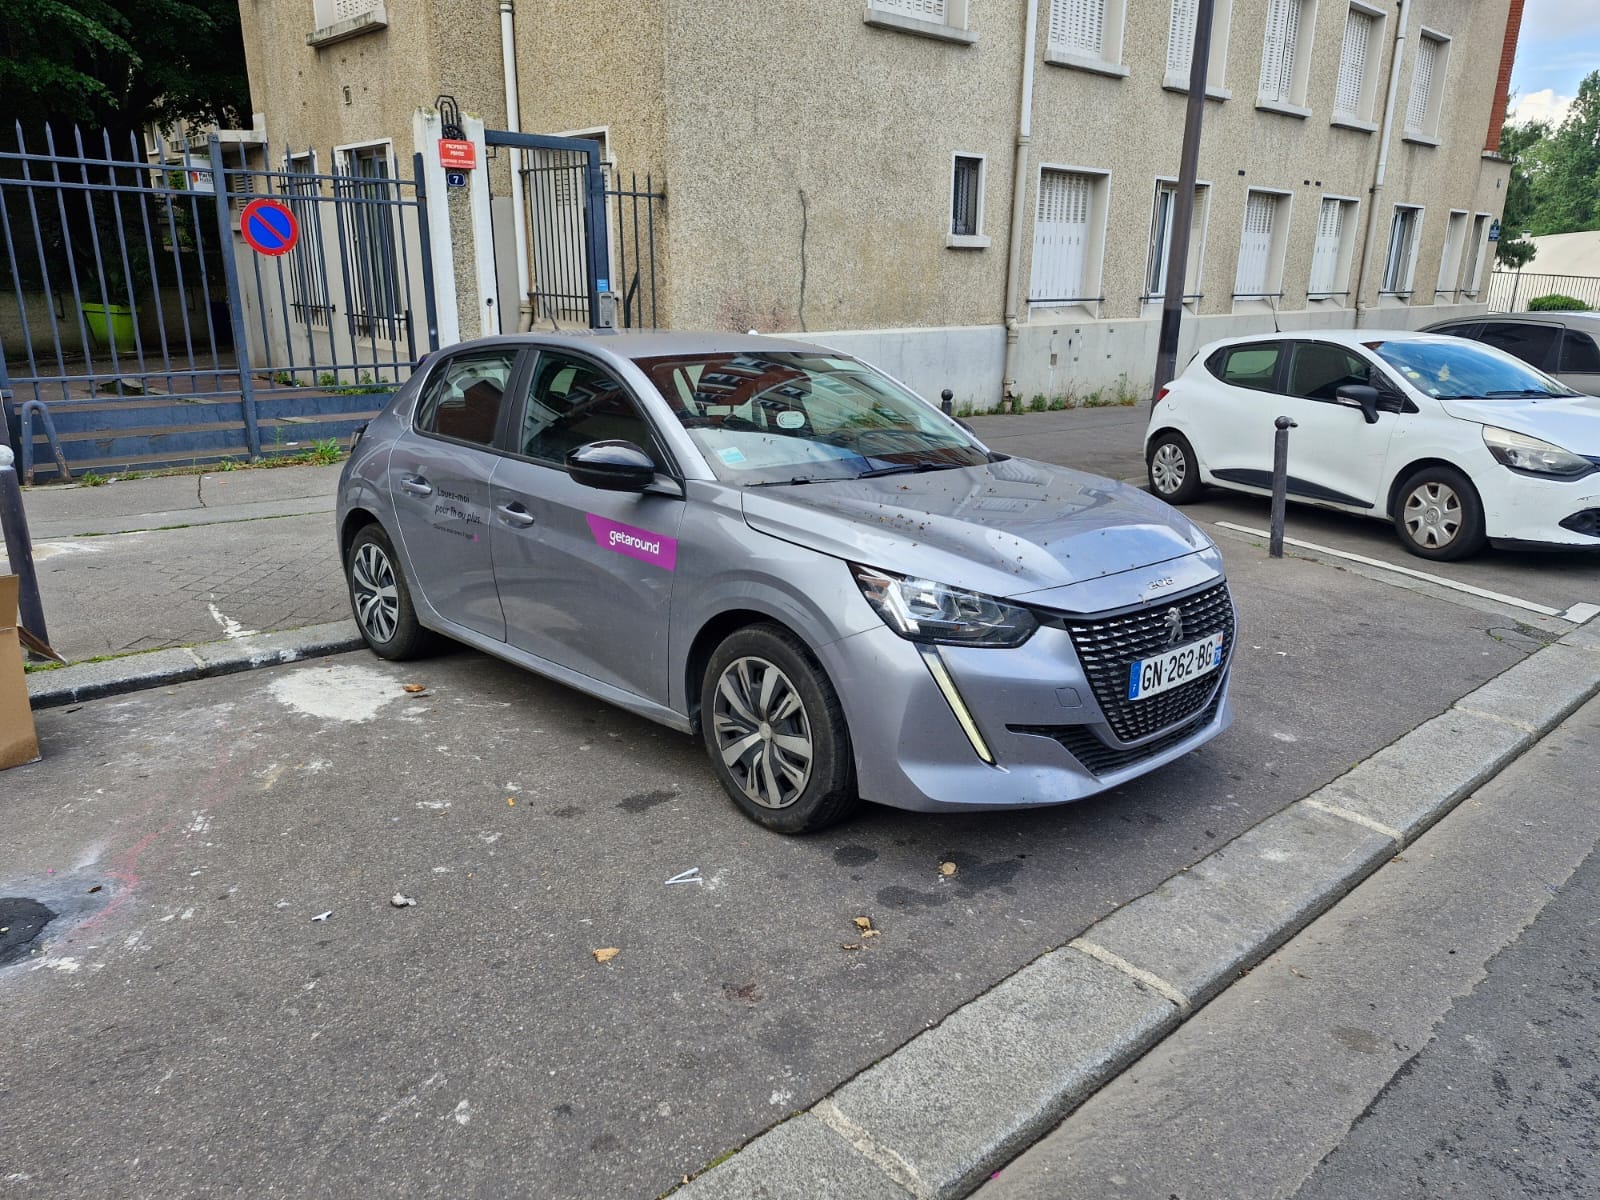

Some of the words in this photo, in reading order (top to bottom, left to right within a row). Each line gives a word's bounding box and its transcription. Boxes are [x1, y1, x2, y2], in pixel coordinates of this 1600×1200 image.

[453, 175, 459, 183] 7
[437, 486, 470, 503] Louez-moi
[609, 530, 660, 555] getaround
